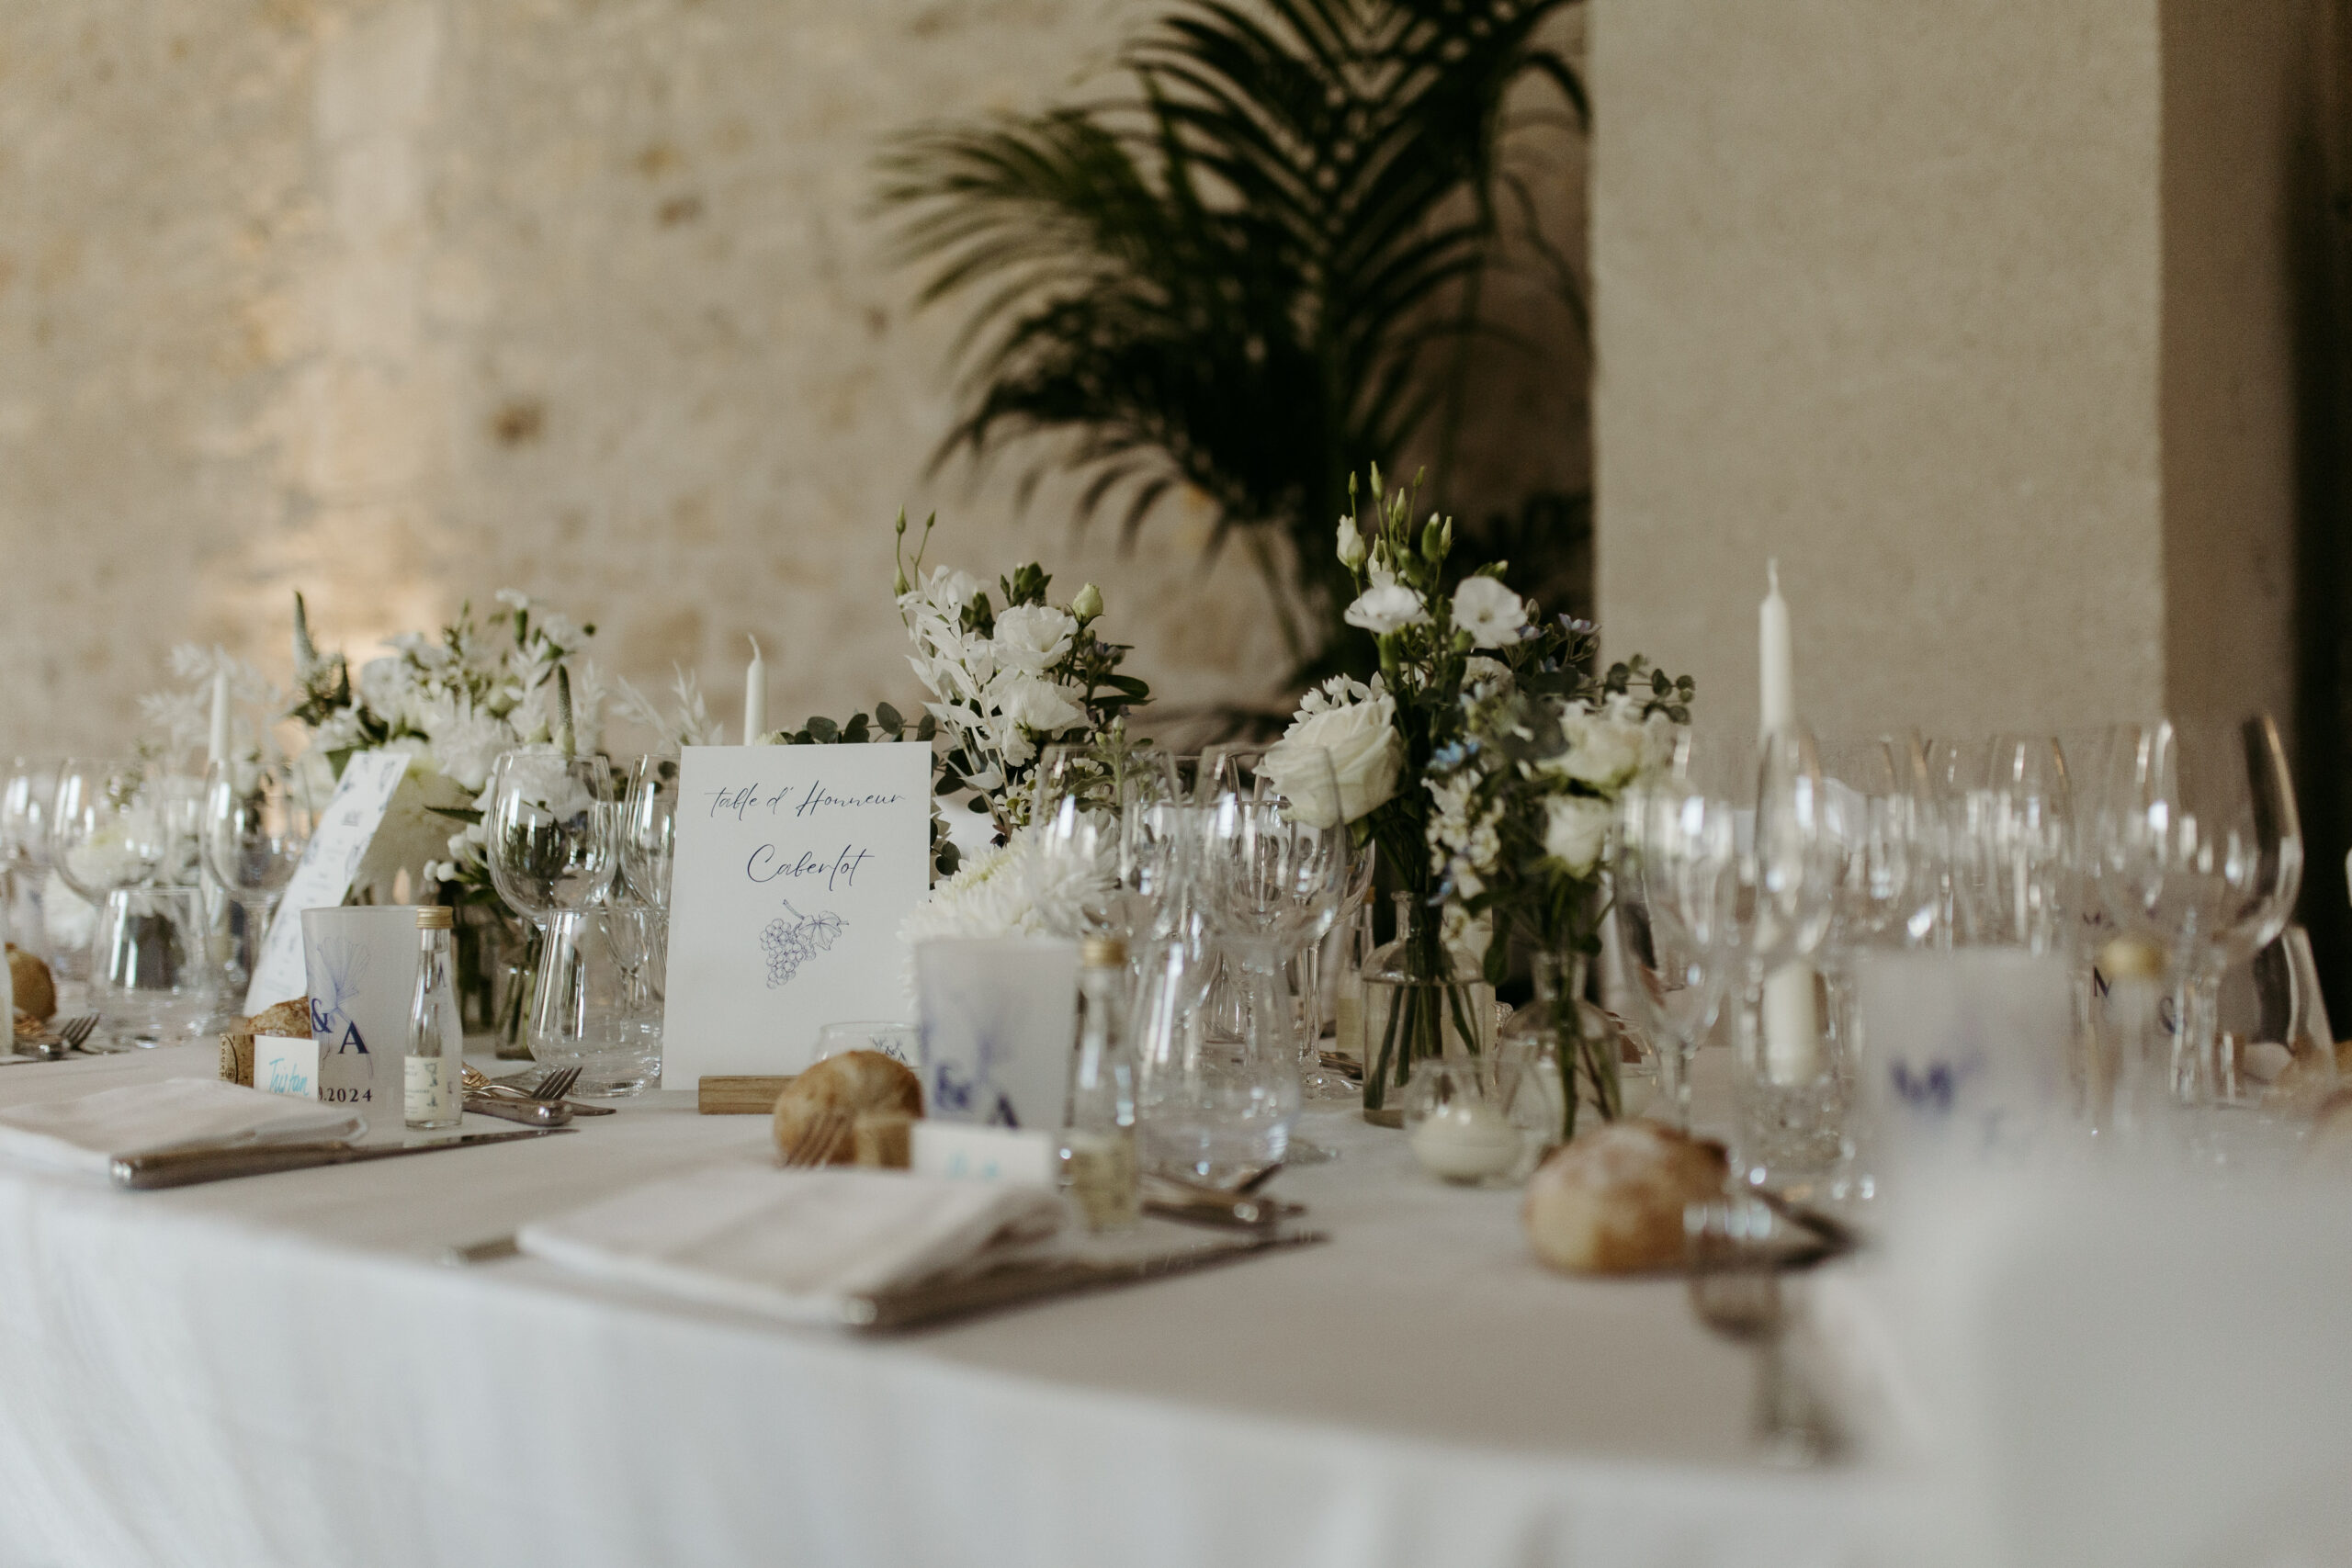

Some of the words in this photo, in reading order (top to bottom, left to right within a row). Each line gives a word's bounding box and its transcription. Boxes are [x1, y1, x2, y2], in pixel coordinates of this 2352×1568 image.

[704, 782, 759, 822] table
[311, 998, 334, 1033] &
[337, 1021, 370, 1055] A
